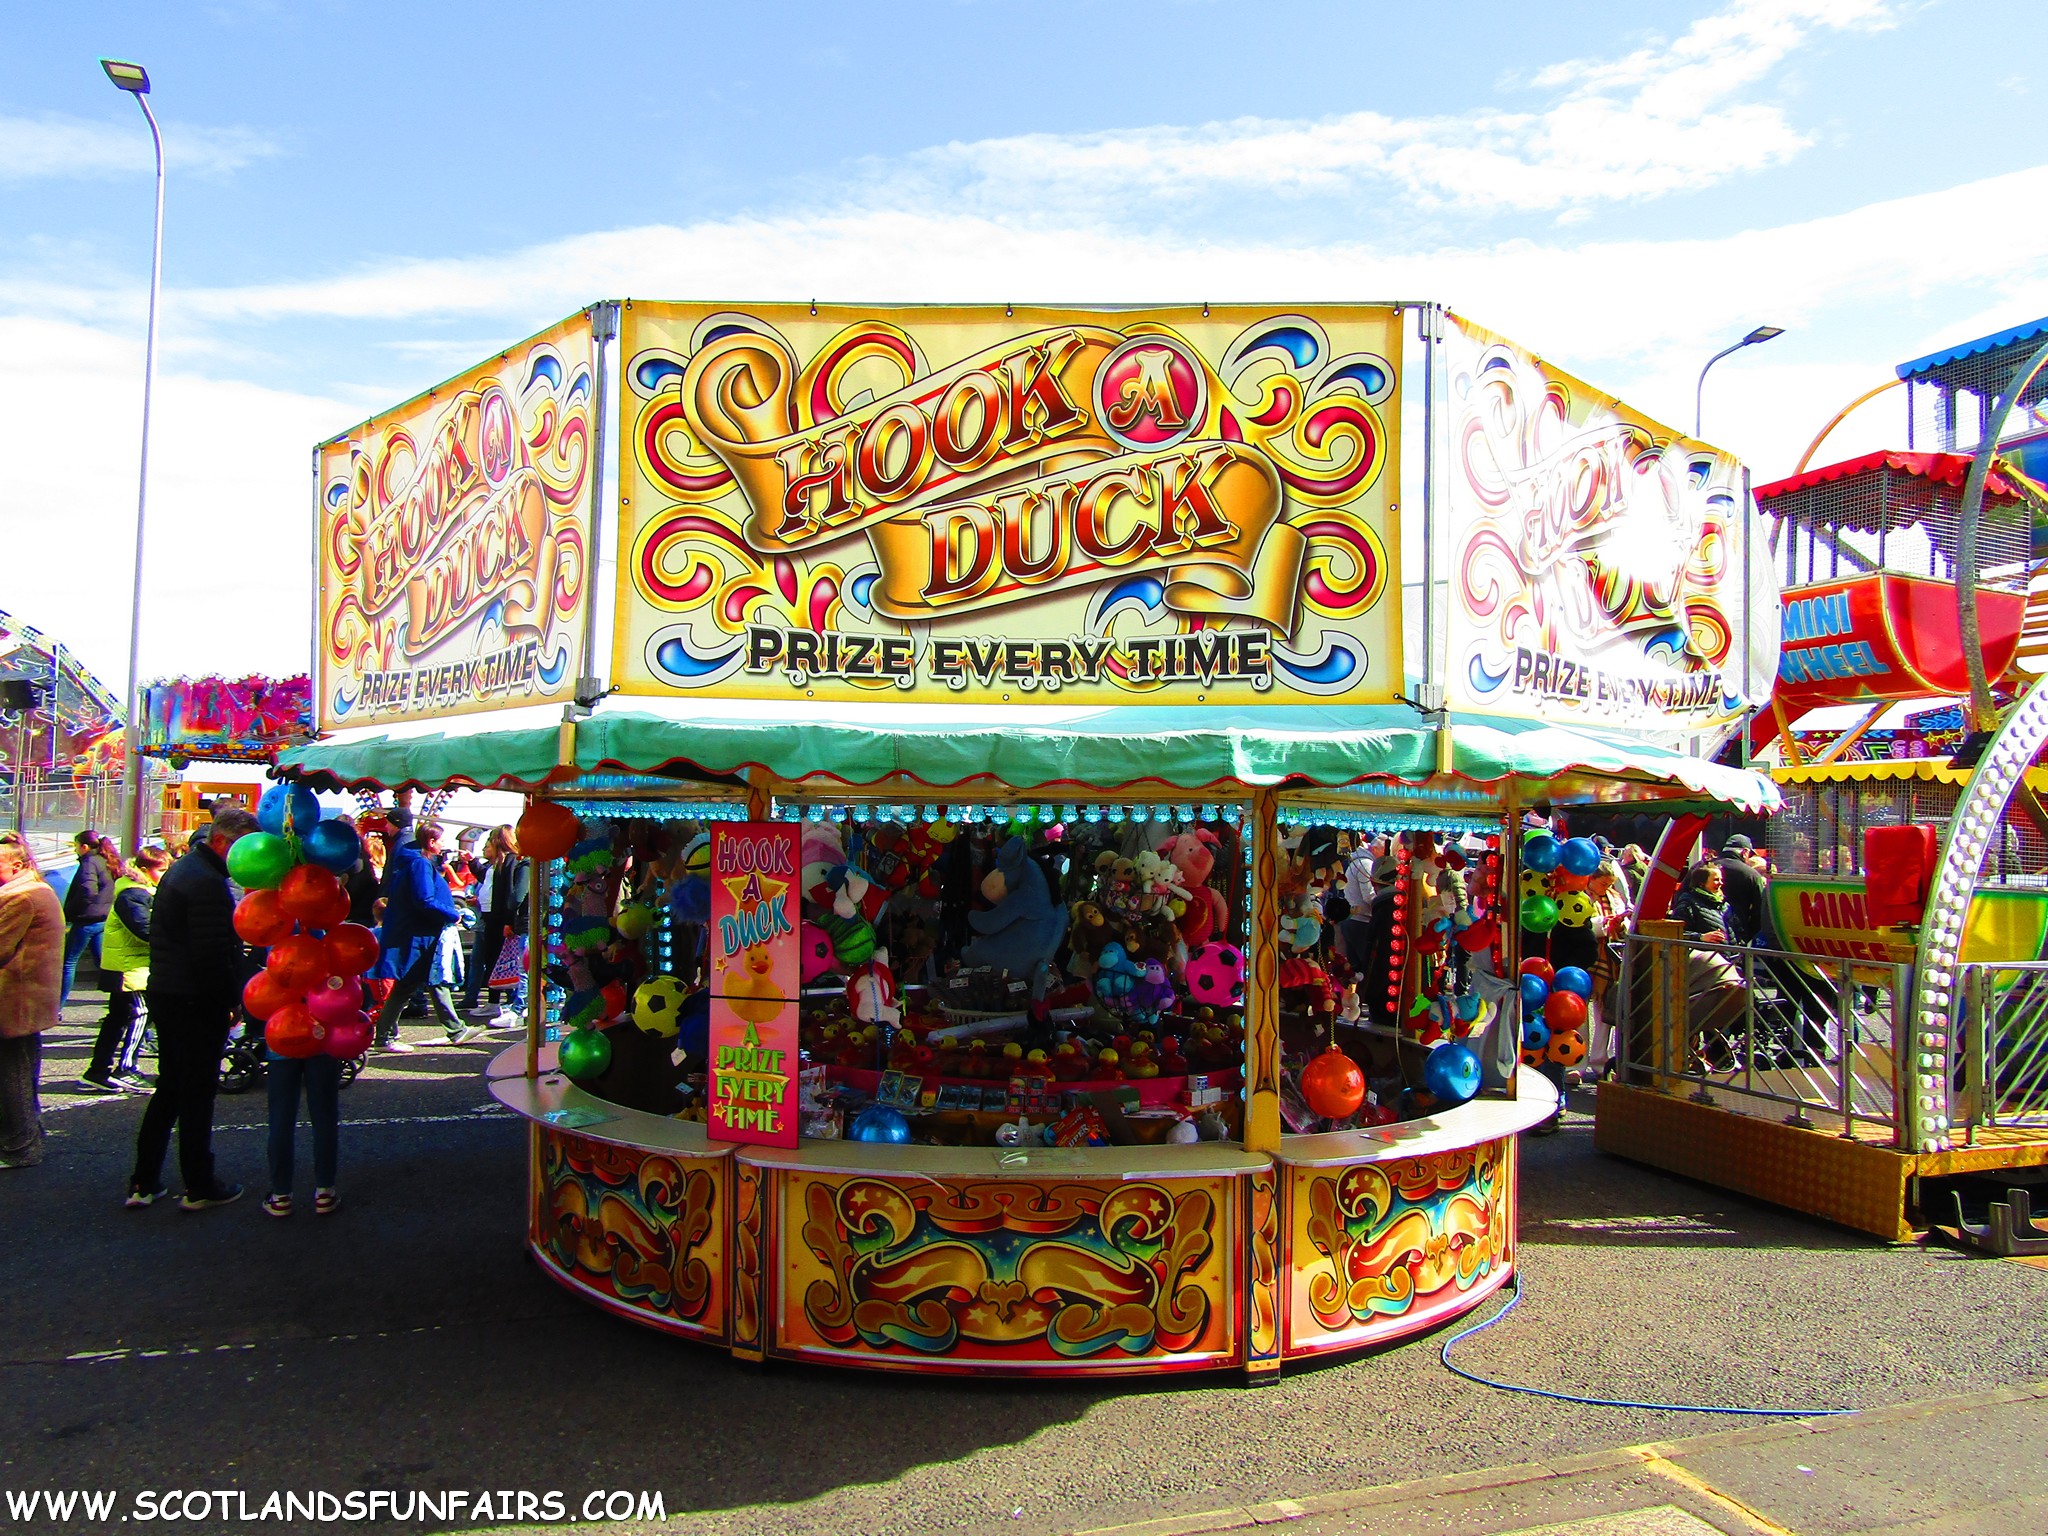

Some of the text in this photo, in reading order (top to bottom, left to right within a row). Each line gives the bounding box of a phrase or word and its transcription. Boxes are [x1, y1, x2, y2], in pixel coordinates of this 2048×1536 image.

[775, 326, 1190, 541] HOOK A
[368, 399, 510, 606] HOOK A
[923, 443, 1241, 607] DUCK
[420, 475, 536, 643] DUCK
[1780, 592, 1853, 643] MINI
[360, 643, 538, 713] PRIZE EVERY TIME
[745, 626, 1275, 691] PRIZE EVERY TIME
[1512, 646, 1590, 708] PRIZE
[1661, 668, 1724, 716] TIME
[1778, 640, 1892, 685] WHEEL
[718, 837, 793, 874] HOOK
[742, 874, 762, 901] A
[719, 894, 791, 954] DUCK
[1791, 935, 1892, 968] WHEE
[743, 1021, 760, 1044] A
[719, 1046, 785, 1074] PRIZE
[717, 1077, 787, 1103] EVERY
[726, 1106, 778, 1133] TIME
